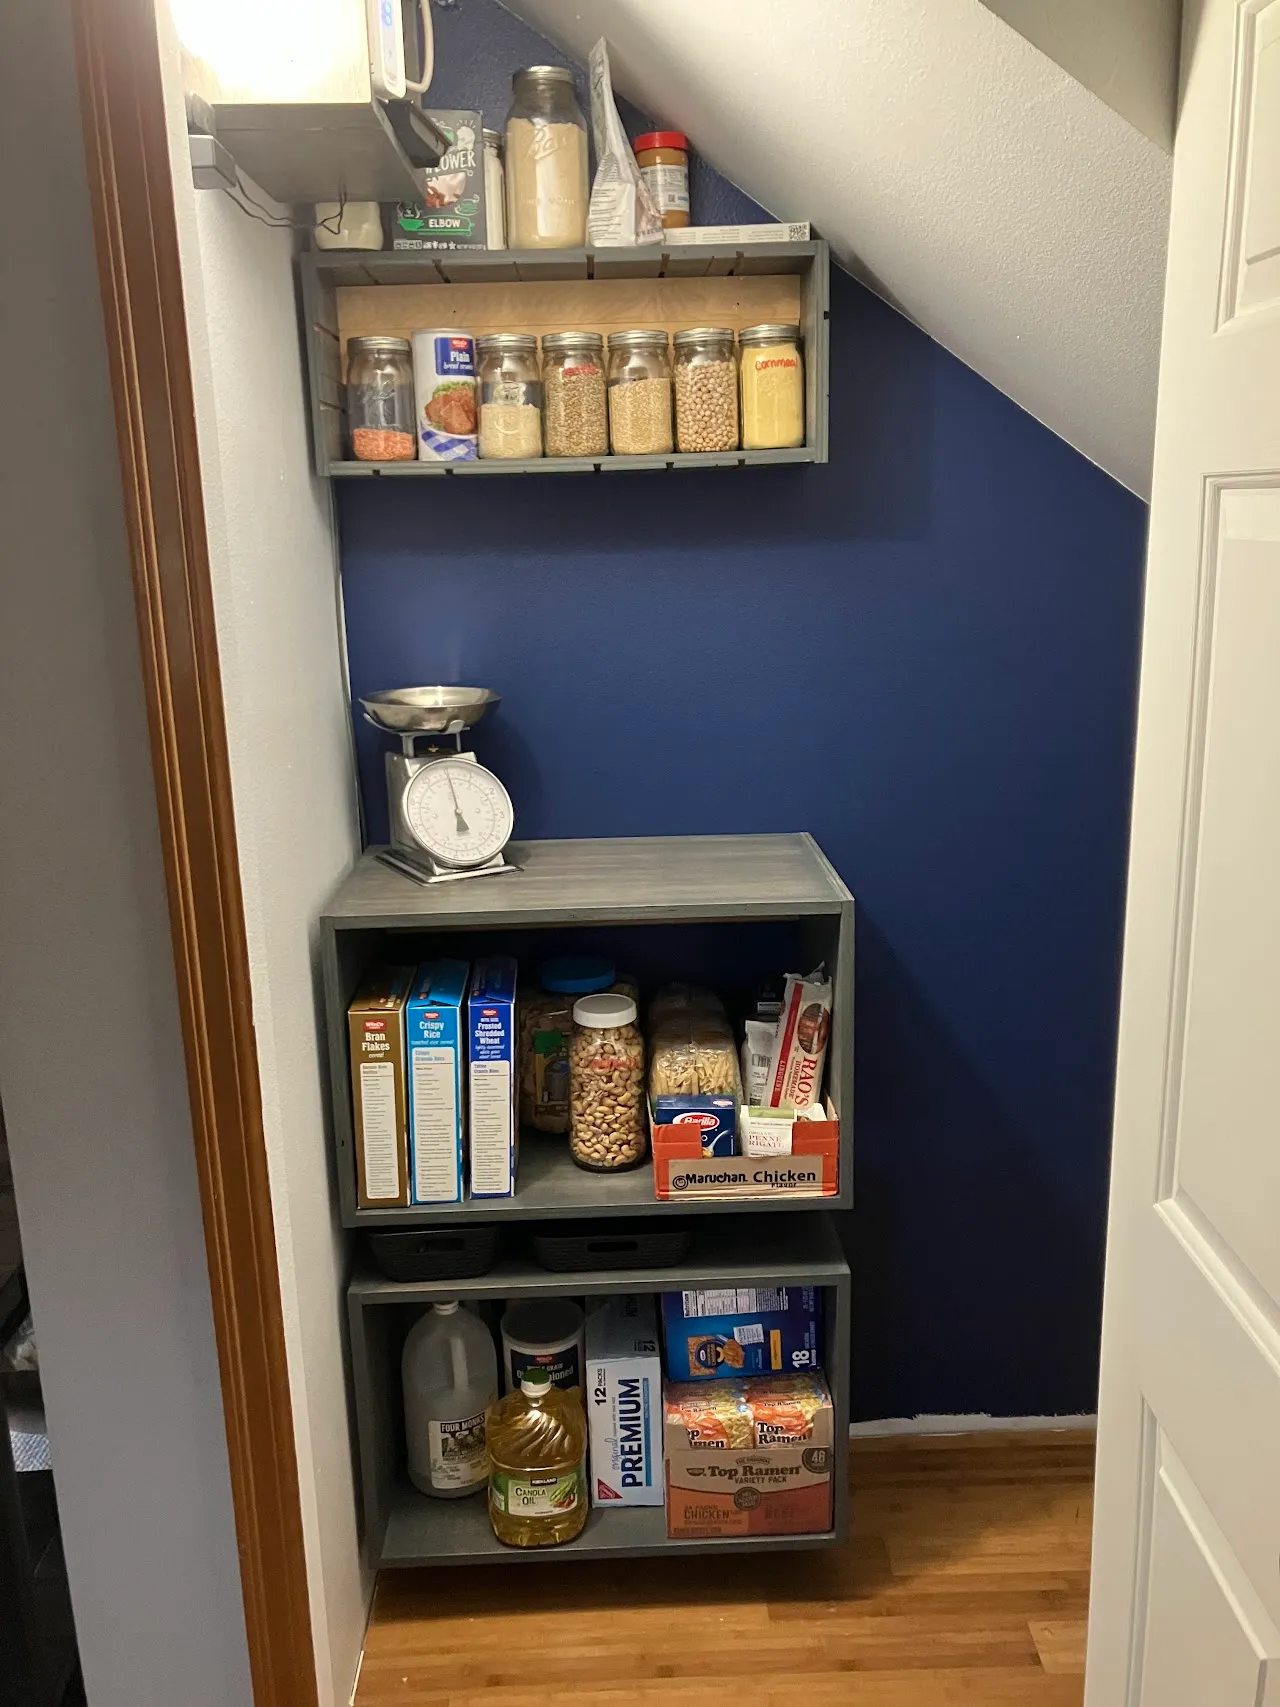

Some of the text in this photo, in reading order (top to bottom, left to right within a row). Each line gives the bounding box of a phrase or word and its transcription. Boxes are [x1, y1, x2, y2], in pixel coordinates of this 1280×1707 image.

[428, 219, 461, 228] ELBOW
[450, 351, 470, 363] Plain
[419, 1021, 445, 1031] Crispy
[477, 1022, 502, 1030] Frosted
[365, 1032, 386, 1041] Bran
[423, 1030, 441, 1039] Rice
[474, 1029, 505, 1037] Shredded
[479, 1037, 500, 1045] Wheat
[361, 1042, 391, 1052] Flakes
[788, 1060, 802, 1100] HOMEMADE
[794, 1056, 818, 1107] RAO'S
[683, 1116, 716, 1126] Barilla
[749, 1134, 782, 1143] PENNE
[685, 1170, 816, 1184] Maruchan Chicken
[791, 1350, 810, 1368] 18
[546, 1363, 563, 1371] GRAIN
[594, 1387, 607, 1406] 12
[441, 1414, 485, 1432] FOUR MONKS
[757, 1422, 784, 1434] Top
[617, 1378, 643, 1488] PREMIUM
[758, 1433, 807, 1445] Ramen
[604, 1438, 626, 1471] original
[708, 1465, 739, 1480] Top
[742, 1465, 801, 1476] Ramen
[735, 1476, 765, 1484] VARIETY
[515, 1487, 547, 1497] CANOLA
[522, 1496, 536, 1505] OIL
[684, 1510, 730, 1519] CHICKEN
